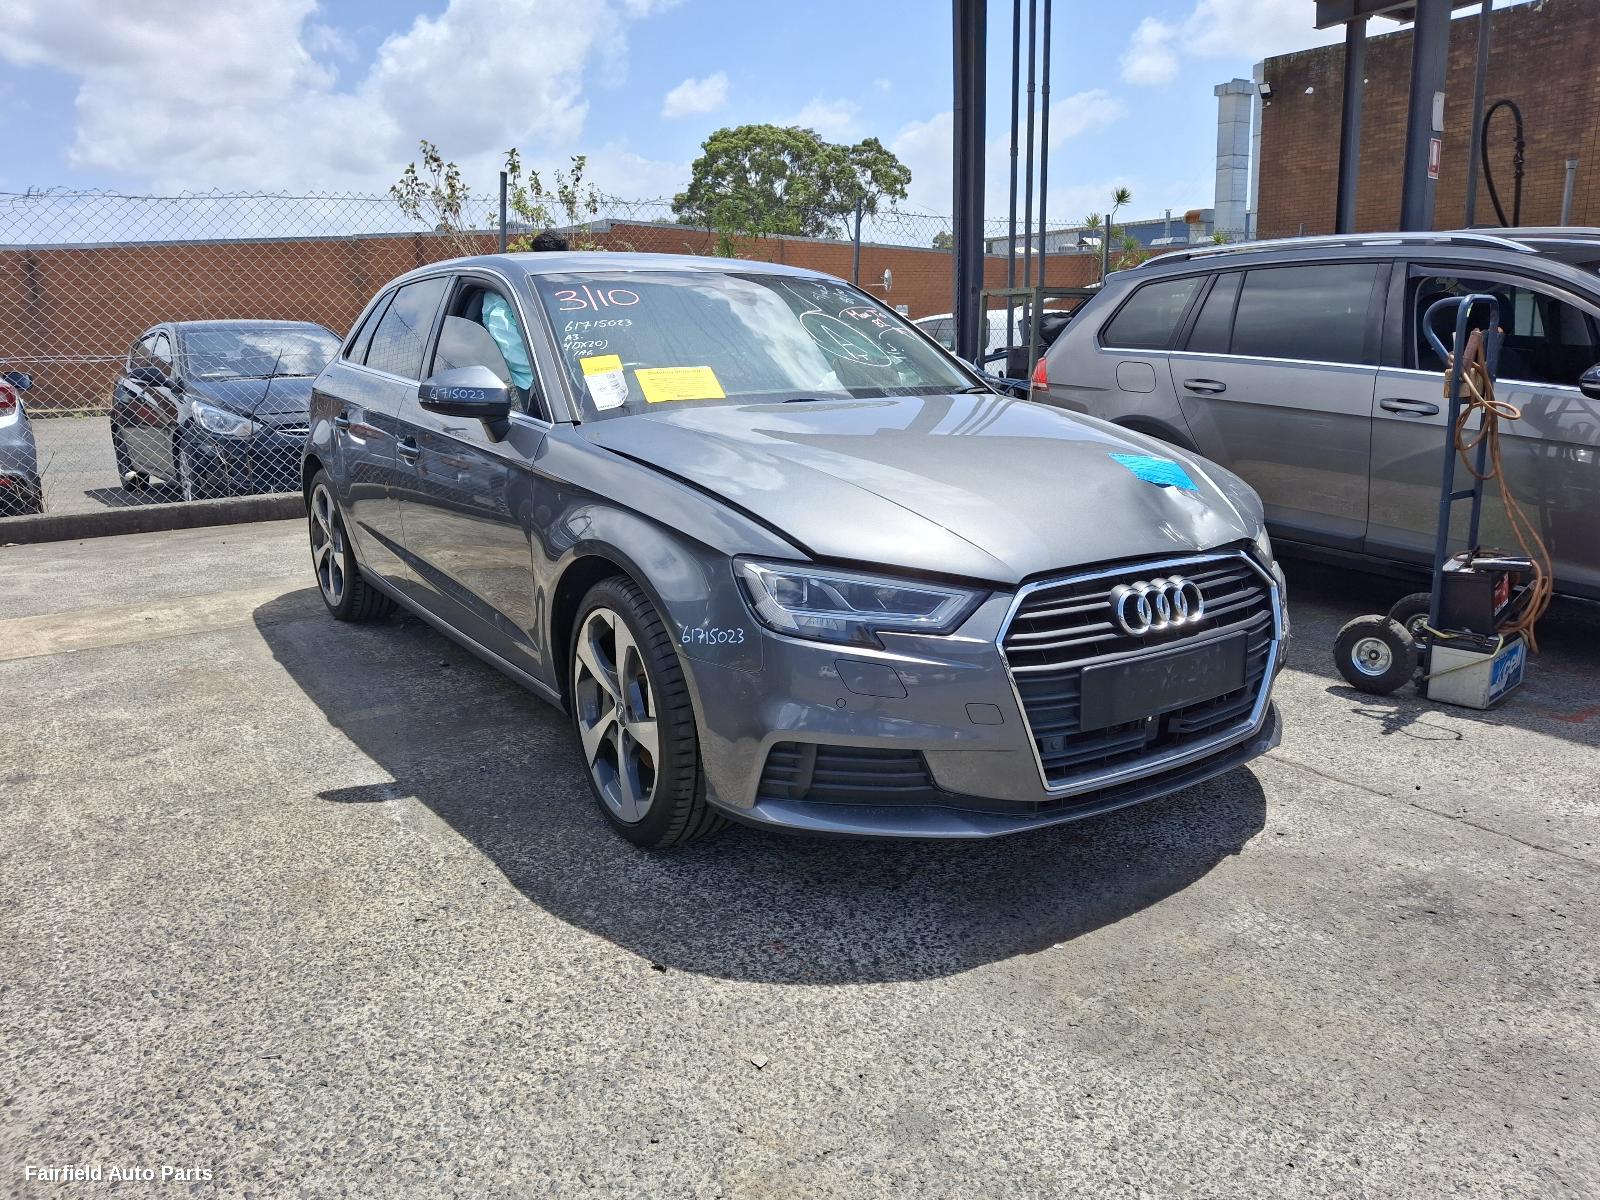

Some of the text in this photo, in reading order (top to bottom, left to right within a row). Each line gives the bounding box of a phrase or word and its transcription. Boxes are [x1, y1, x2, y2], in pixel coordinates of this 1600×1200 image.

[564, 318, 633, 332] 61715023
[429, 386, 485, 400] 61715023
[681, 625, 745, 645] 61715023
